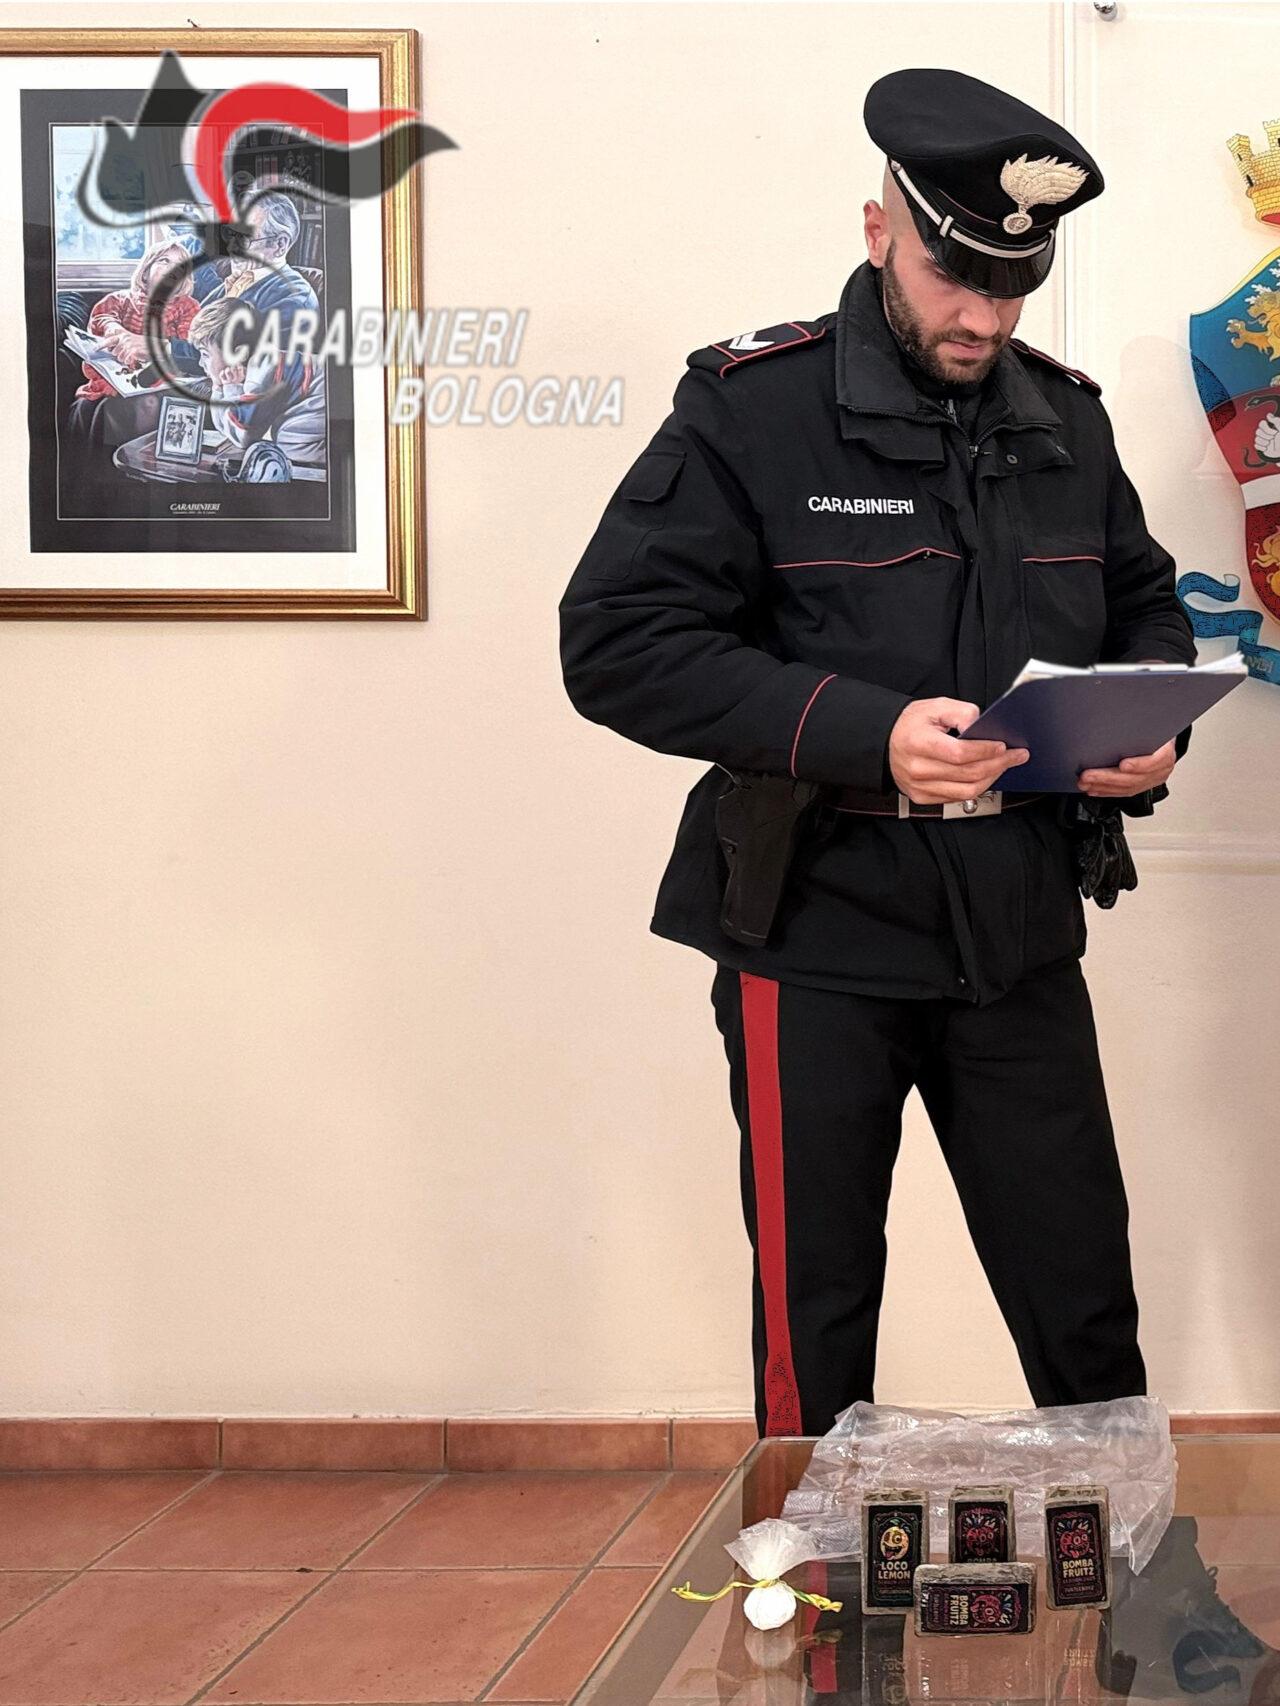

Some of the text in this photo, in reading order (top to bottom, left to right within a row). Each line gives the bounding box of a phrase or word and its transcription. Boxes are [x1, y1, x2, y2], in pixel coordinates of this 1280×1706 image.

[808, 496, 915, 515] CARABINIERI
[881, 1561, 908, 1571] LOCO
[1062, 1558, 1095, 1570] BOMBA
[878, 1570, 911, 1580] LEMON
[1063, 1567, 1095, 1579] FRUITZ
[950, 1594, 960, 1626] FRUITZ
[959, 1595, 969, 1626] BOMBA
